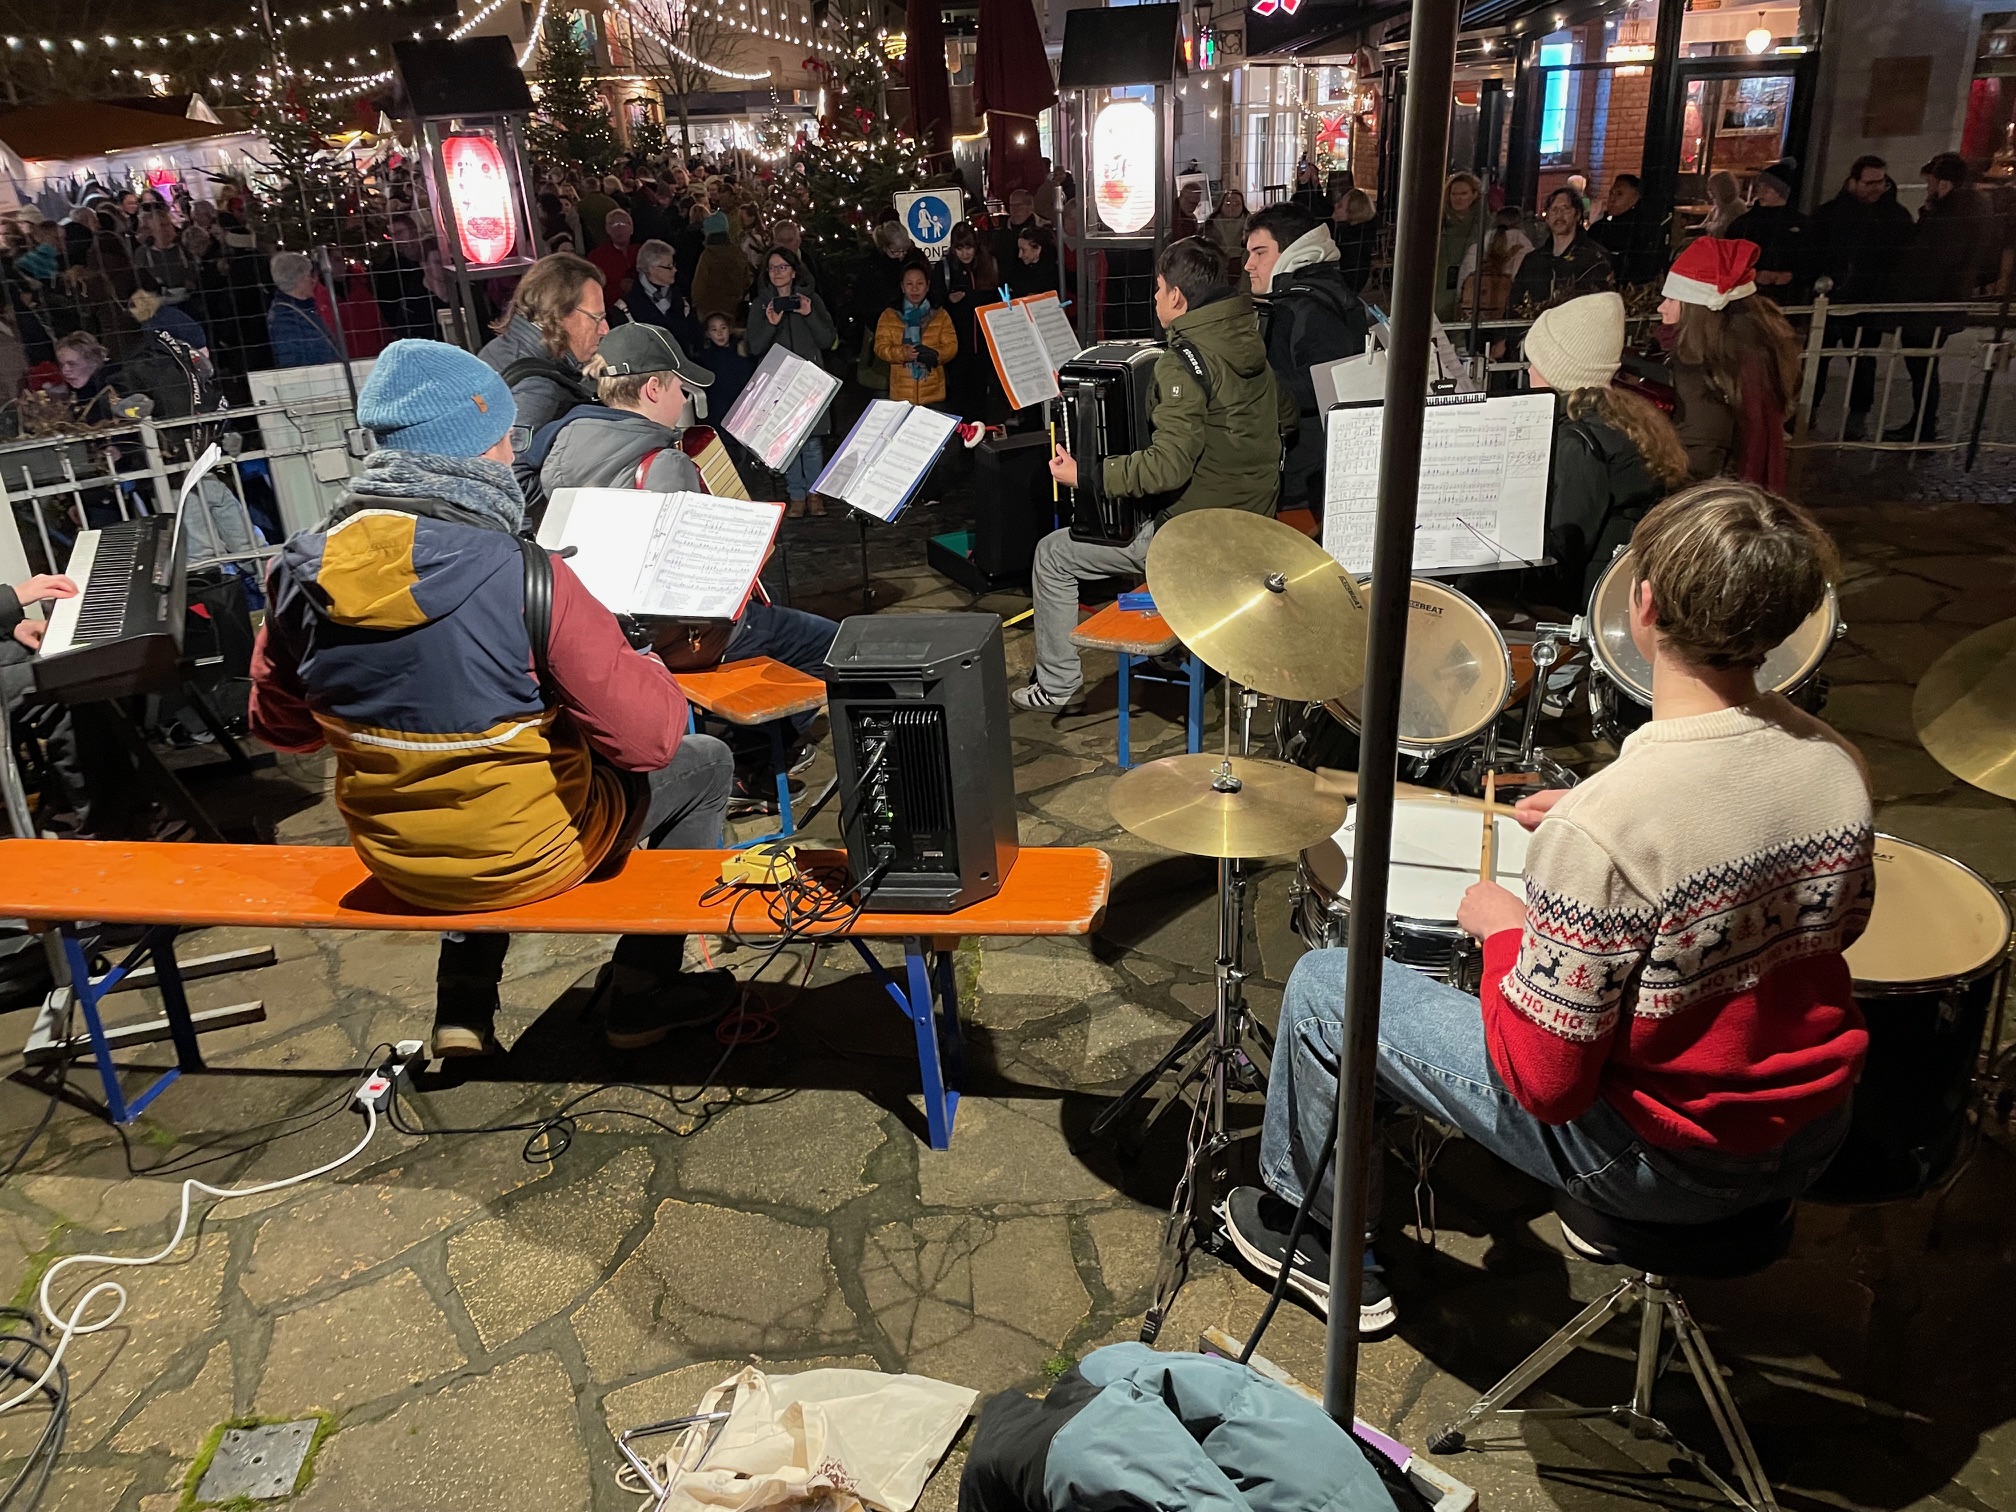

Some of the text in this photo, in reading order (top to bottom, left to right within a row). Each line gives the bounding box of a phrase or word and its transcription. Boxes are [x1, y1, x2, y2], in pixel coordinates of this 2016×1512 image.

[923, 246, 949, 259] ONE
[1520, 990, 1544, 1014] HO
[1553, 1008, 1584, 1030] HO
